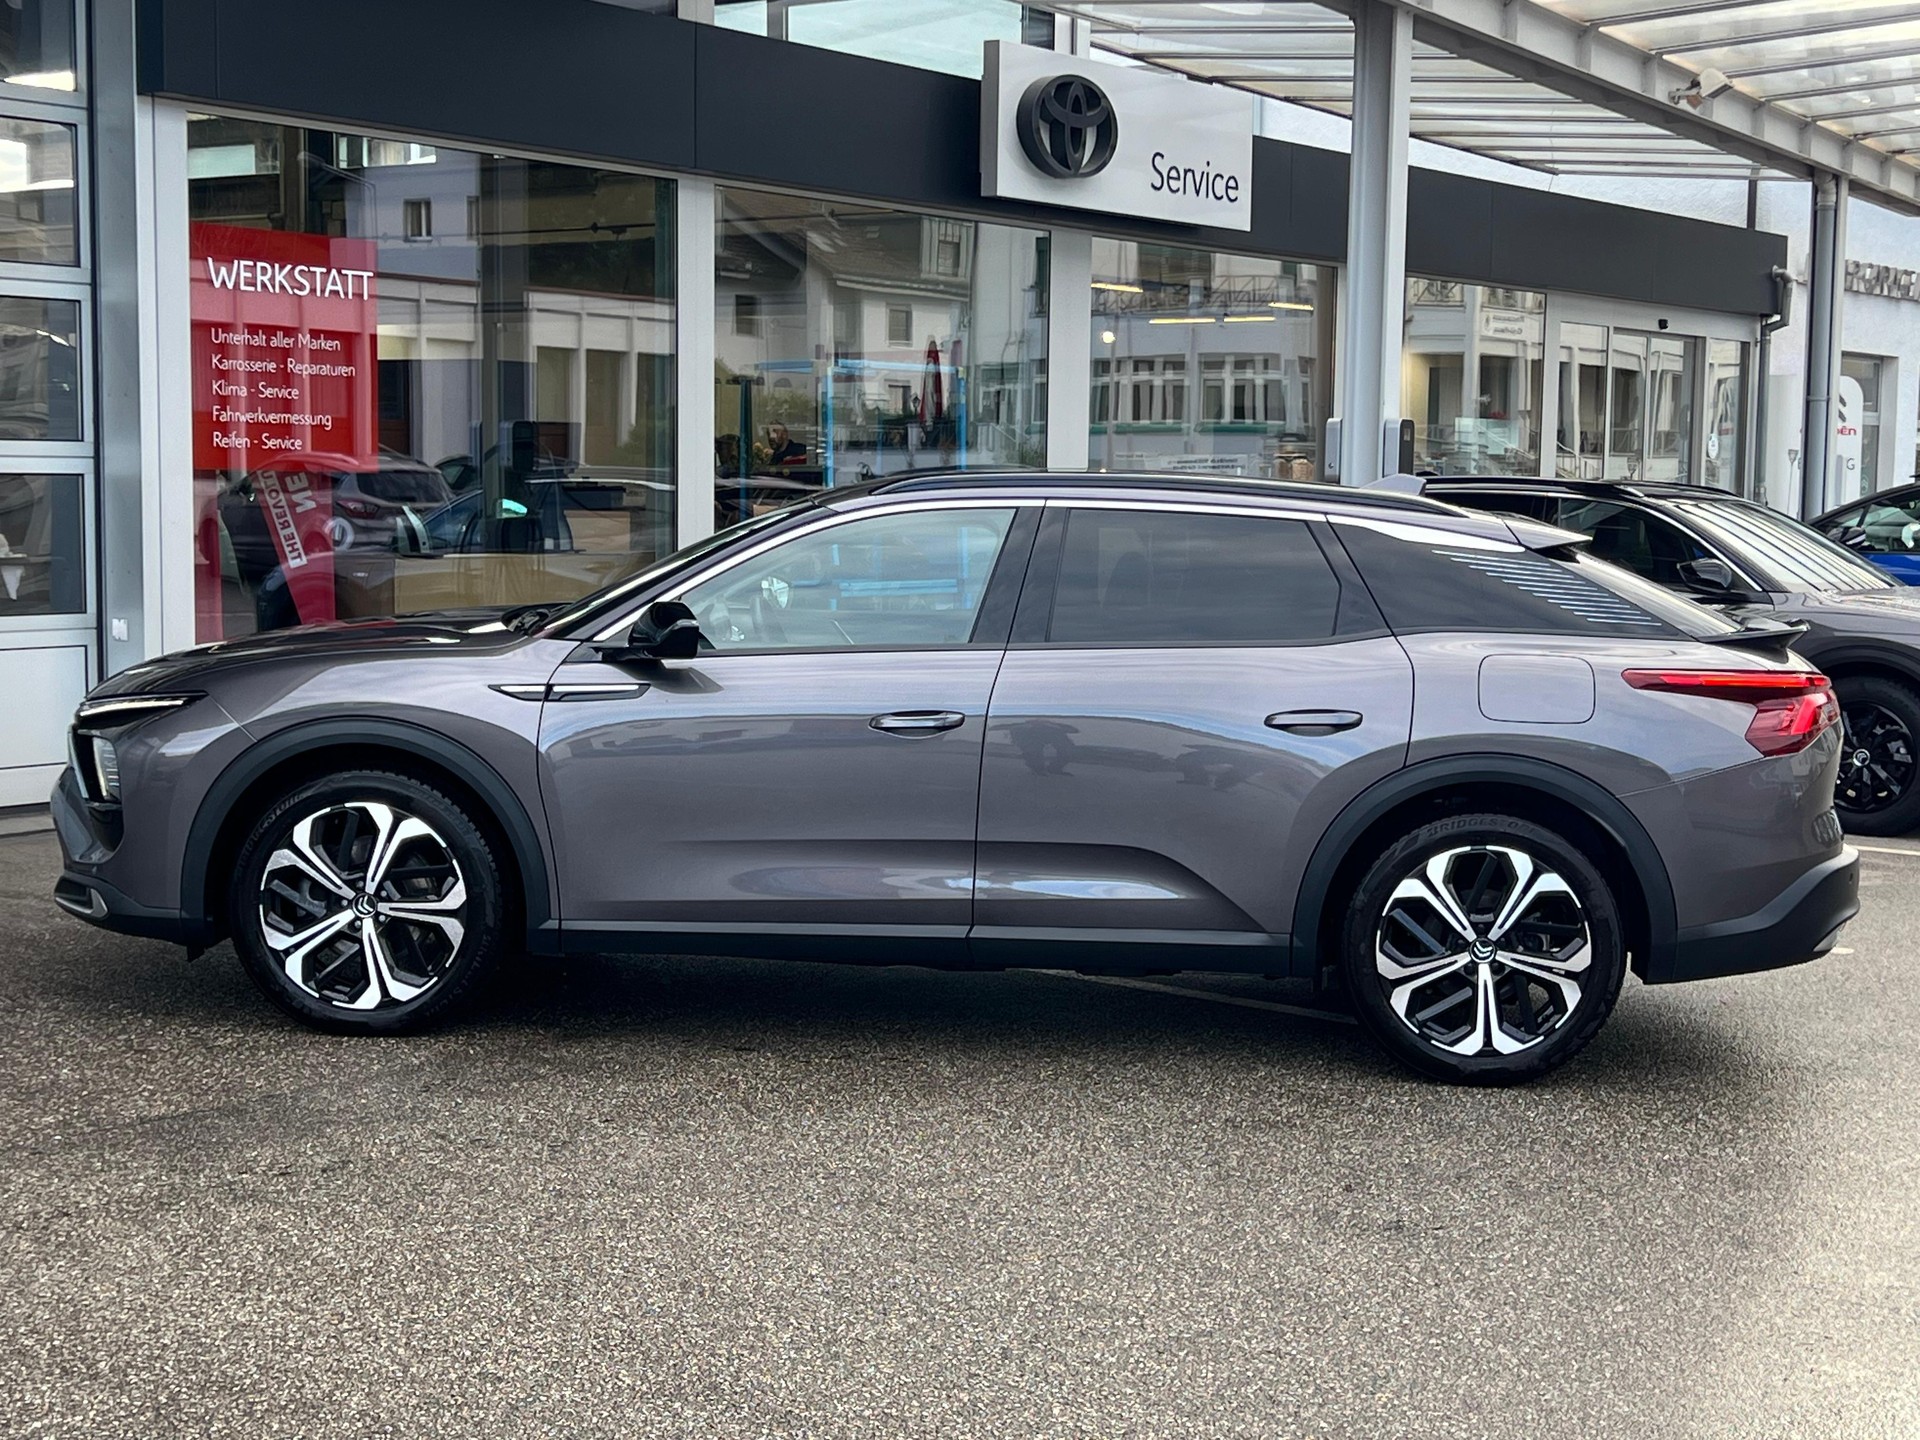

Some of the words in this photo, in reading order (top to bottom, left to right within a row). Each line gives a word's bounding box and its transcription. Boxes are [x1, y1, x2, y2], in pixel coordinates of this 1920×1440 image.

[1150, 151, 1239, 203] Service
[207, 256, 374, 301] WERKSTATT
[211, 327, 267, 347] Unterhalt
[270, 331, 294, 348] aller
[298, 333, 341, 351] Marken
[211, 353, 277, 373] Karrosserie
[287, 357, 356, 380] Reparaturen
[212, 379, 248, 397] Klima
[258, 382, 300, 400] Service
[212, 405, 332, 431] Fahrwerkvermessung
[213, 431, 251, 449] Reifen
[261, 433, 303, 450] Service
